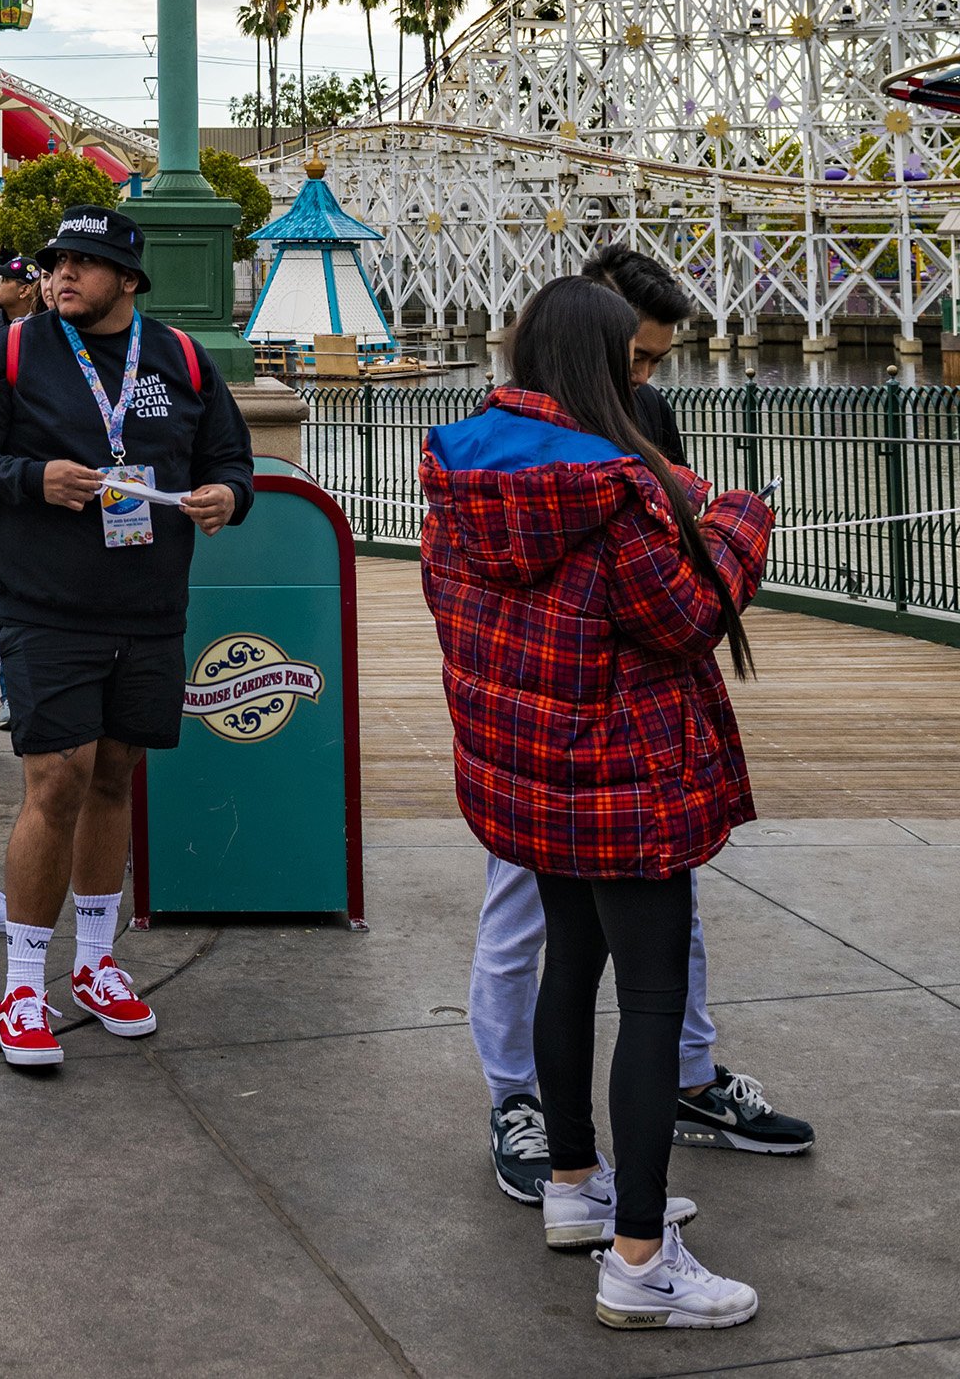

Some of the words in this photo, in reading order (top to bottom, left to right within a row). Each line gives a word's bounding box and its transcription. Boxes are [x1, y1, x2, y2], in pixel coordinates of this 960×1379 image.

[129, 395, 173, 409] SOCIAL
[136, 406, 169, 418] CLUB
[183, 686, 231, 707] ARADISE
[233, 670, 283, 699] GARDENS
[285, 670, 314, 689] PARK
